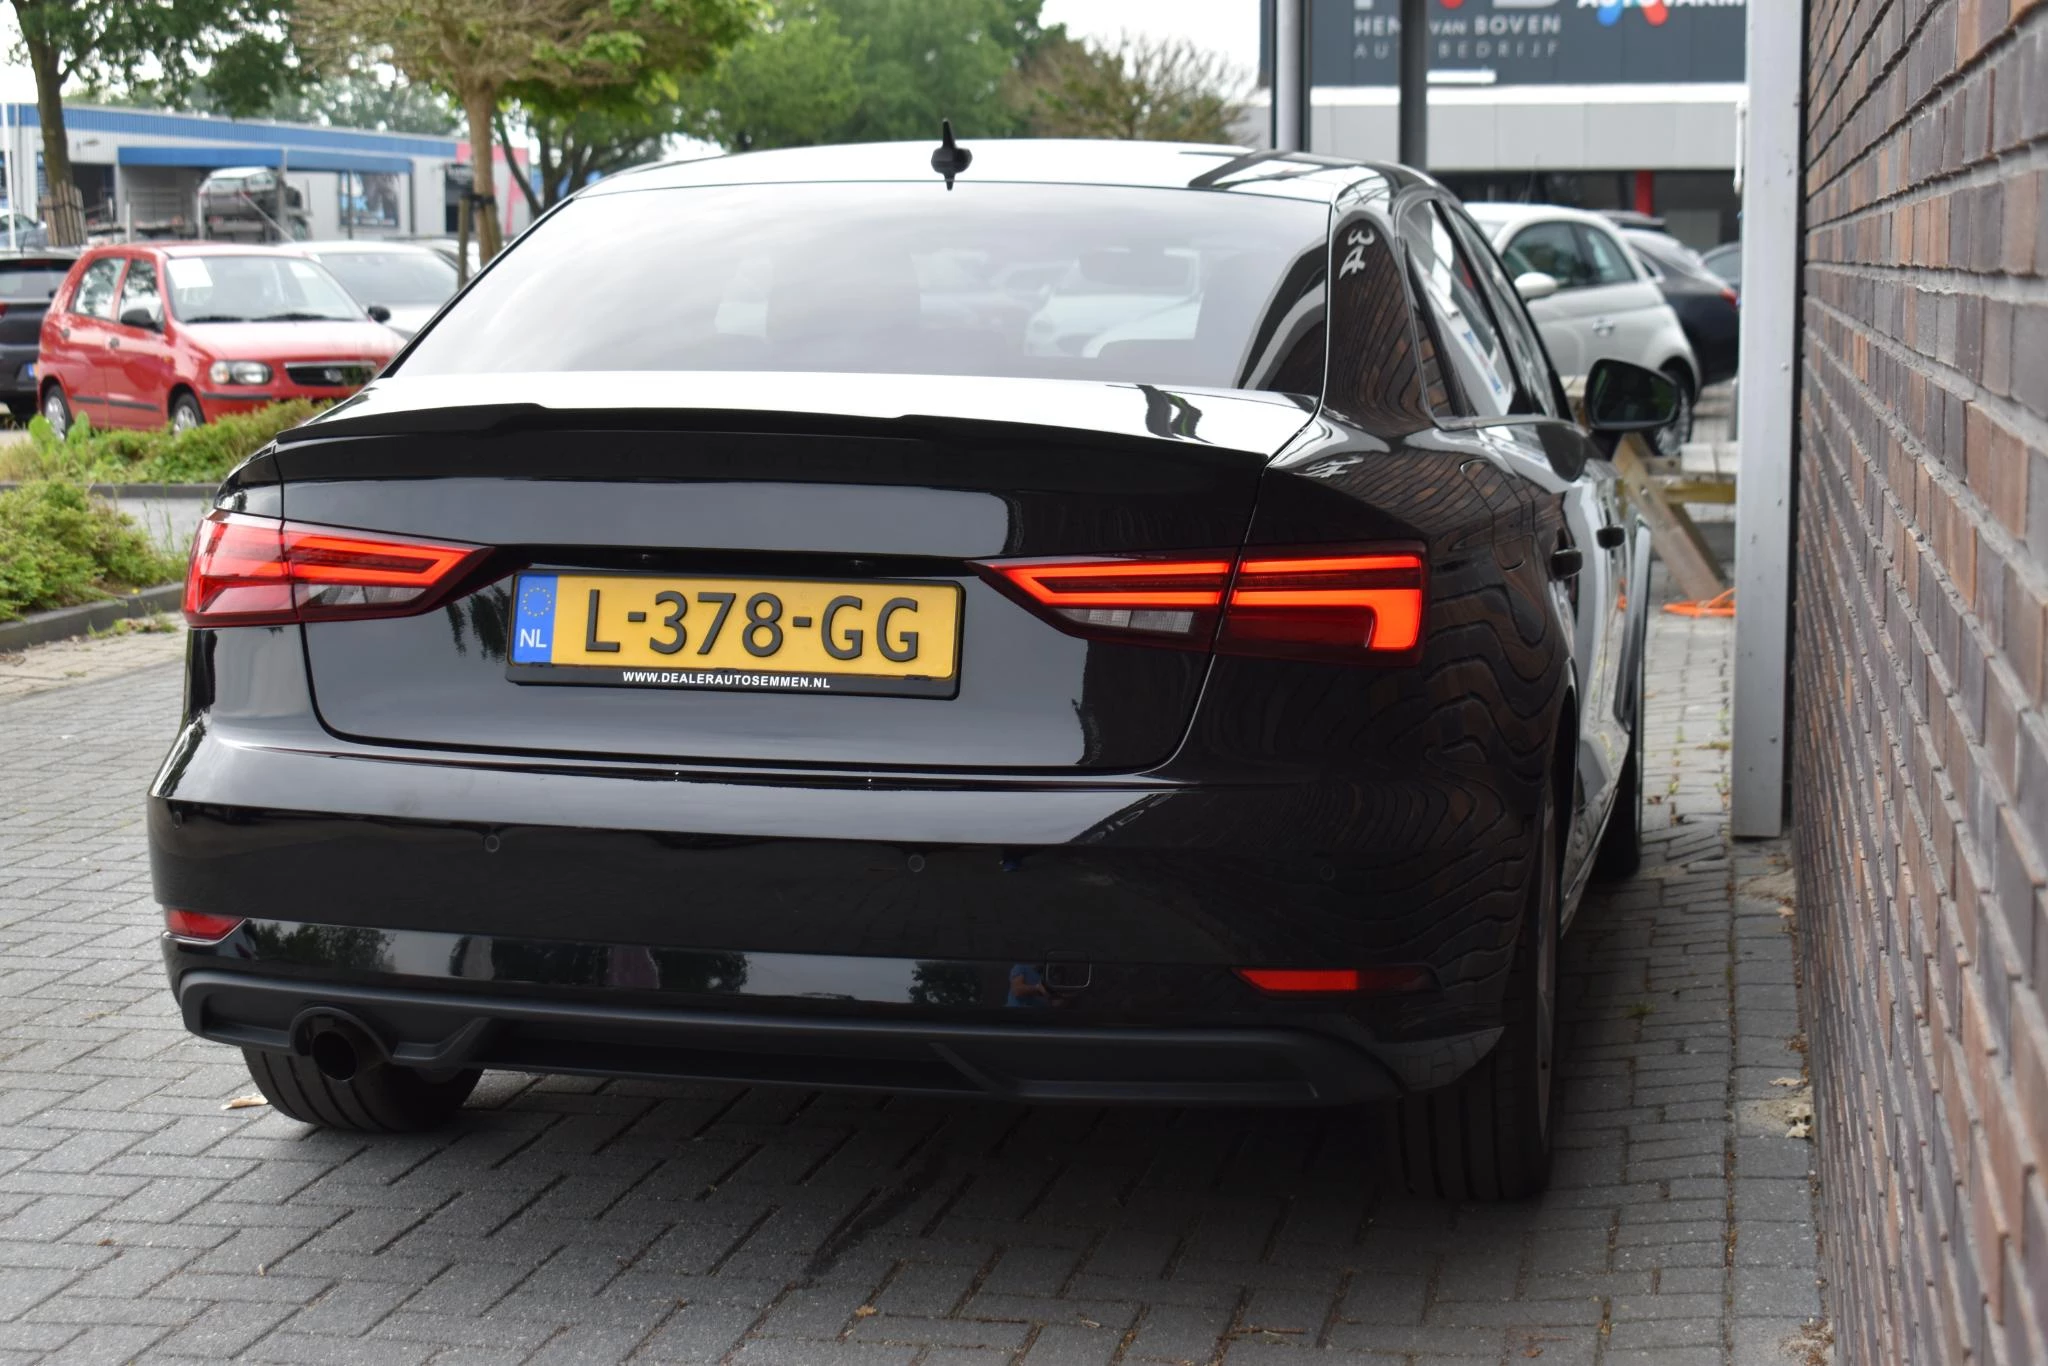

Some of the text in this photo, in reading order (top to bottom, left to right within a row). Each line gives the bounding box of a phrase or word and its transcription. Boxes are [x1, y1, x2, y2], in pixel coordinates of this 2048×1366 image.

[1353, 14, 1562, 37] HEN VAN BOVEN
[585, 589, 920, 663] L-378-GG
[519, 627, 548, 649] NL
[622, 671, 831, 689] WWW.DEALERAUTOSEMMEN.NL
